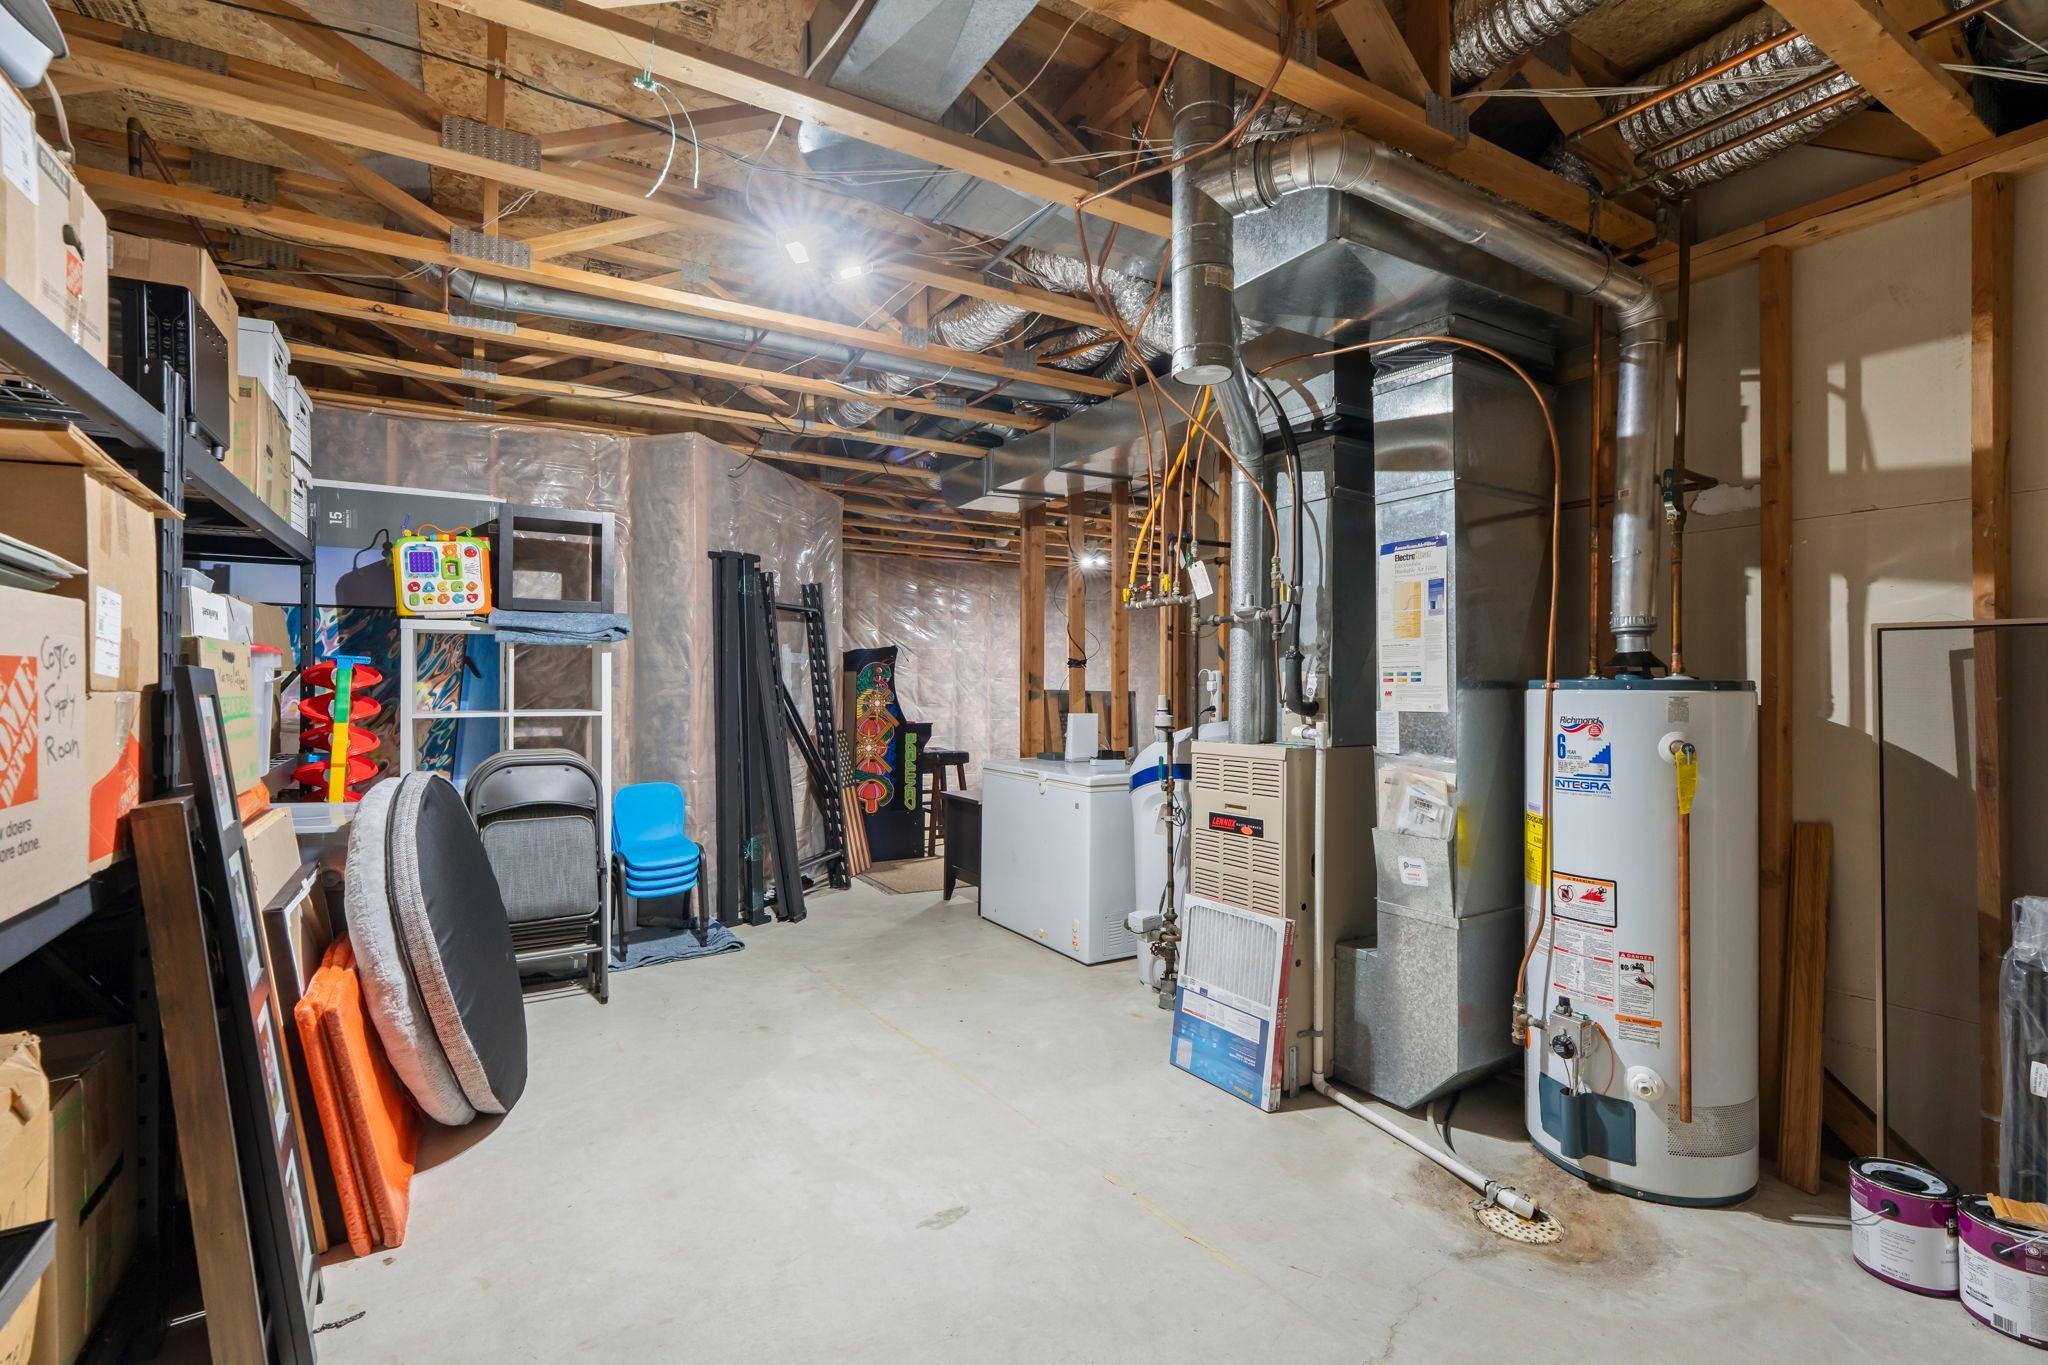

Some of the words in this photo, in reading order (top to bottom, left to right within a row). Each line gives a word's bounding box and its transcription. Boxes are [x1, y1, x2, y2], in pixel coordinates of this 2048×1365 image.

[329, 511, 343, 524] 15
[1560, 716, 1600, 724] Richmond
[45, 735, 80, 766] Room
[1557, 733, 1566, 759] 6
[904, 732, 917, 811] CENTIPEDE
[1555, 780, 1611, 791] INTEGRA
[6, 818, 32, 838] doers
[1212, 816, 1237, 827] LENNOX
[0, 845, 16, 862] ore
